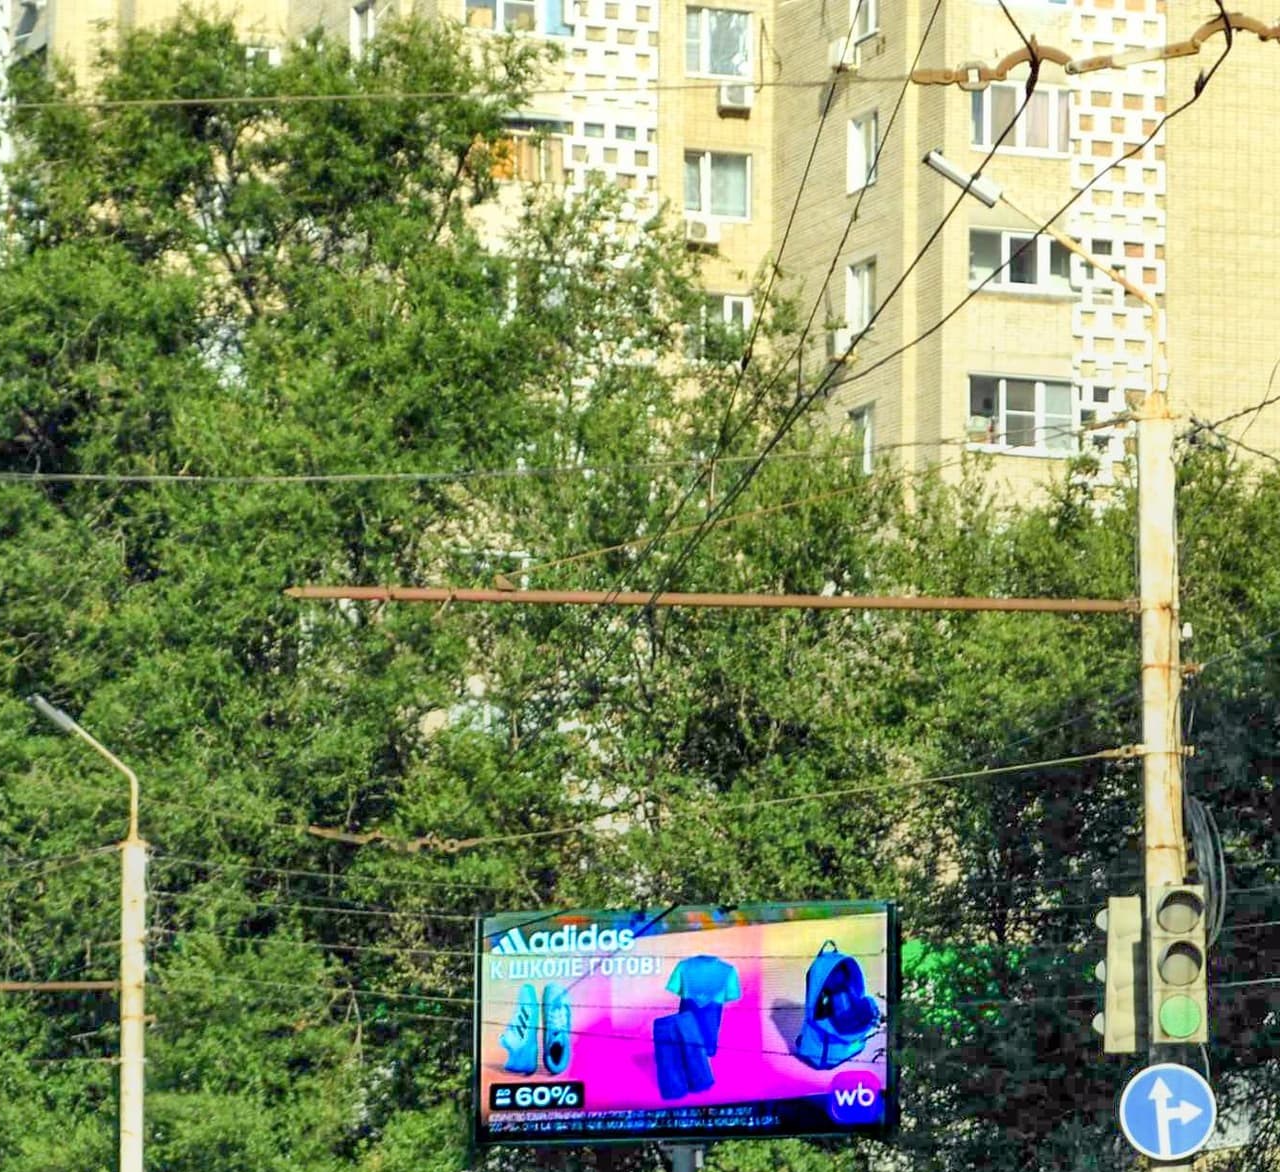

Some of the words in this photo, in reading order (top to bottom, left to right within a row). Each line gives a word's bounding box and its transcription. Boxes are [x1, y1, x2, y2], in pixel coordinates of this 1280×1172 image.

[528, 924, 635, 953] adidas
[490, 960, 506, 979] К
[508, 957, 583, 979] ШКОЛЕ
[590, 957, 661, 976] ГОТОВ!
[835, 1081, 874, 1106] wb
